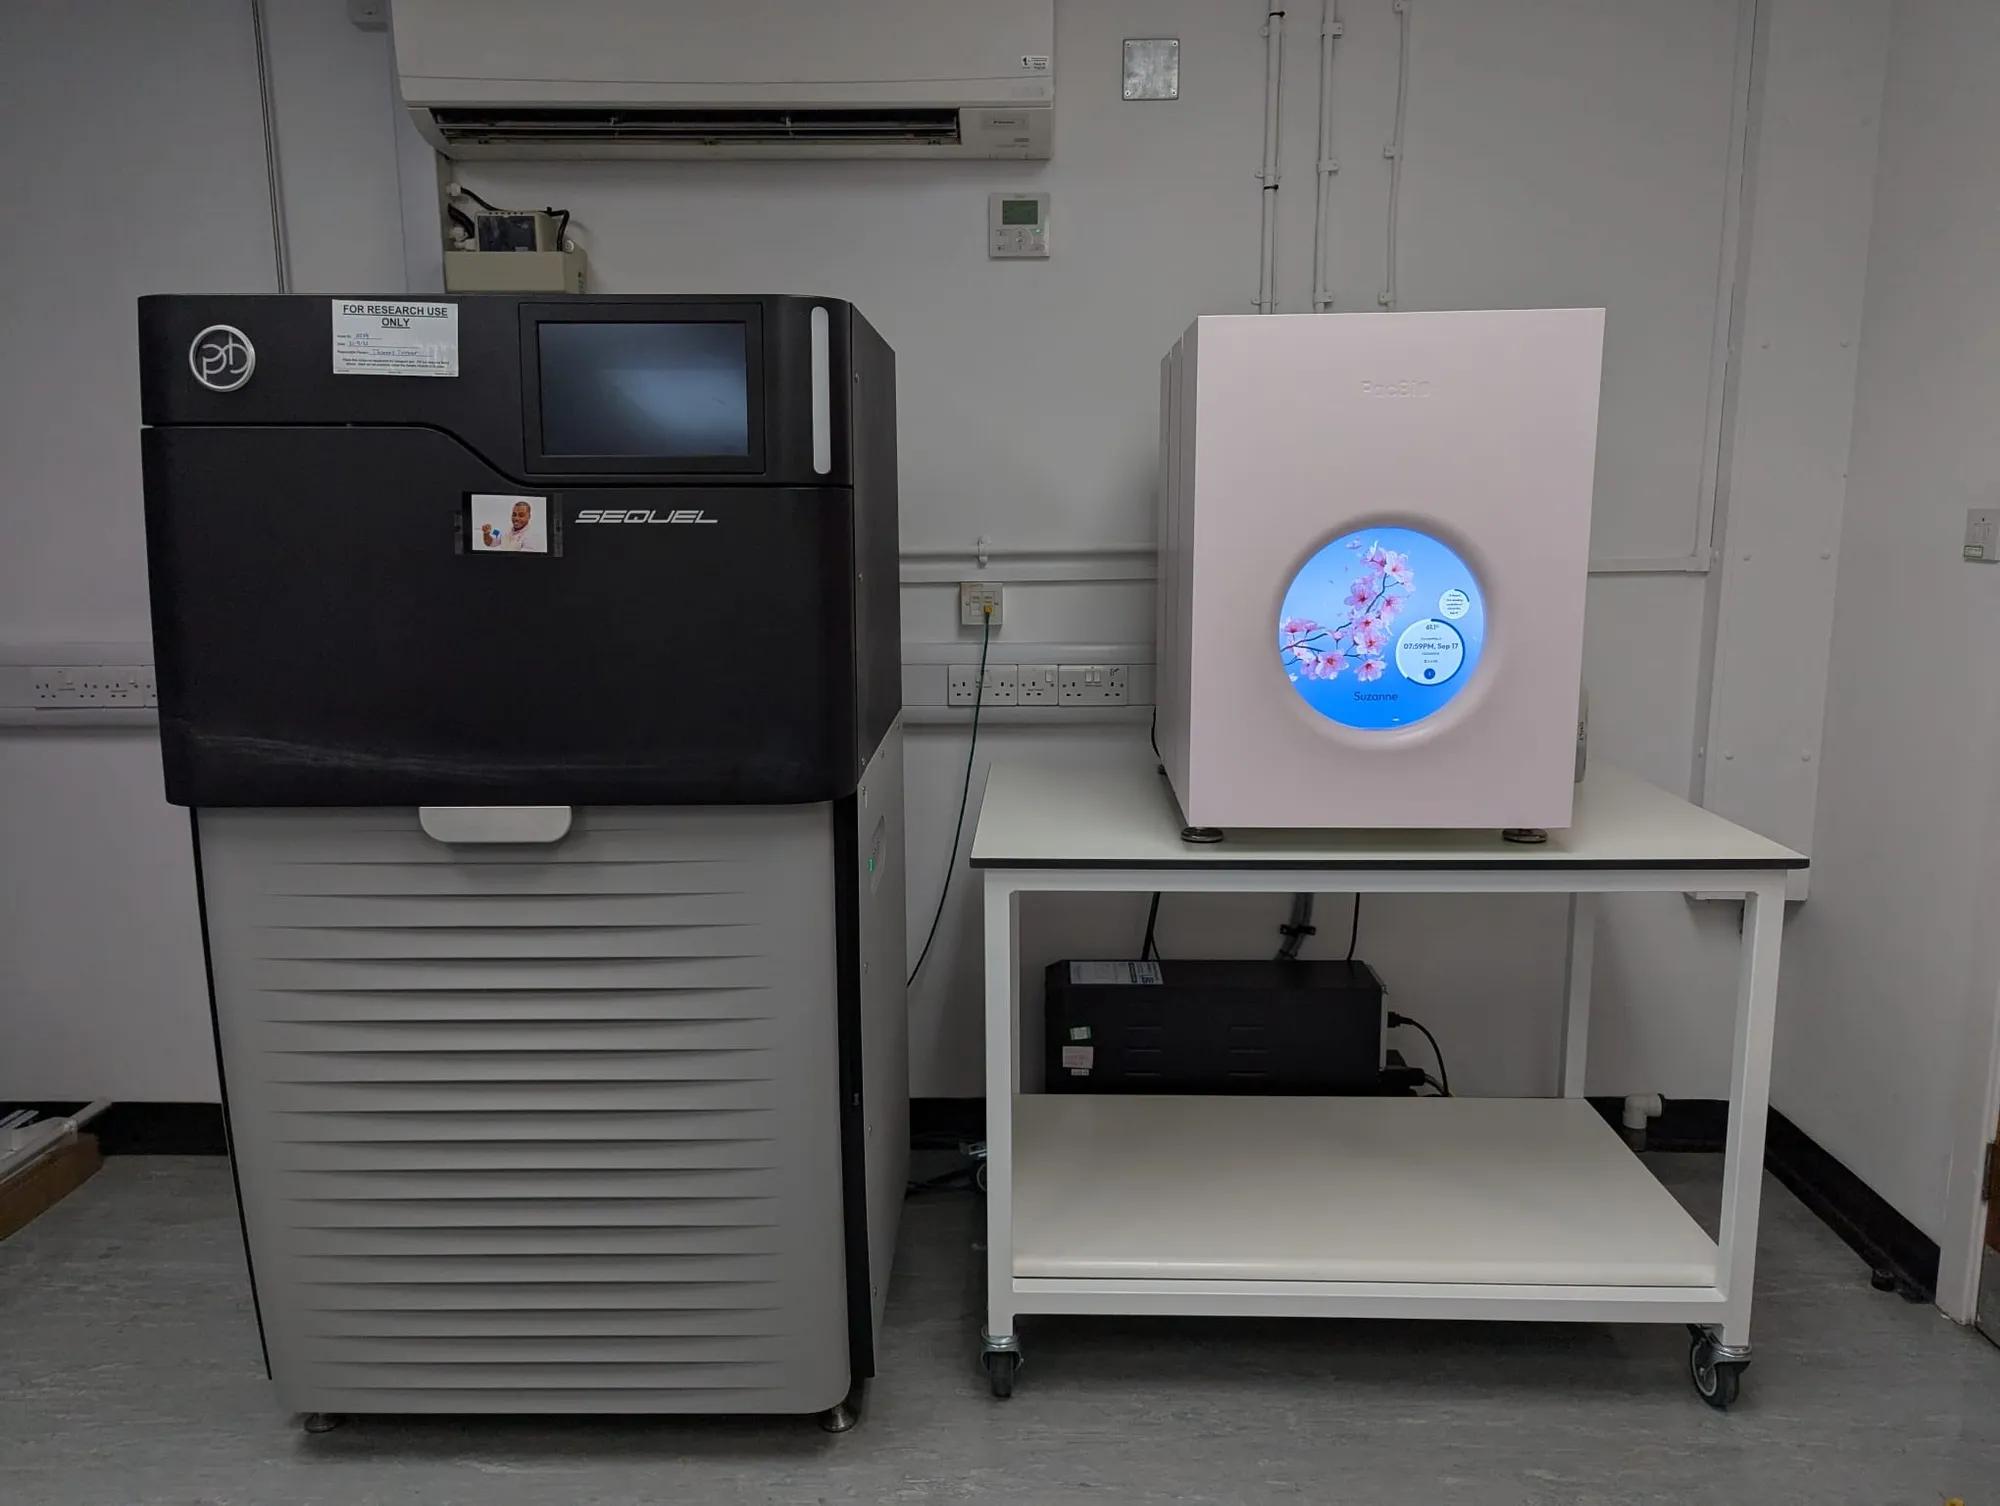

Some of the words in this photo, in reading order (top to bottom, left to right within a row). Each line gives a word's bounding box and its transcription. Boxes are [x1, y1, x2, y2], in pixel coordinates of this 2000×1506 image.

[343, 304, 365, 314] FOR
[367, 305, 425, 315] RESEARCH
[427, 307, 448, 316] USE
[381, 317, 410, 326] ONLY
[575, 510, 719, 524] SEQUEL
[1437, 642, 1451, 650] Sep
[1451, 642, 1459, 650] 17
[1353, 691, 1399, 701] Suzanne
